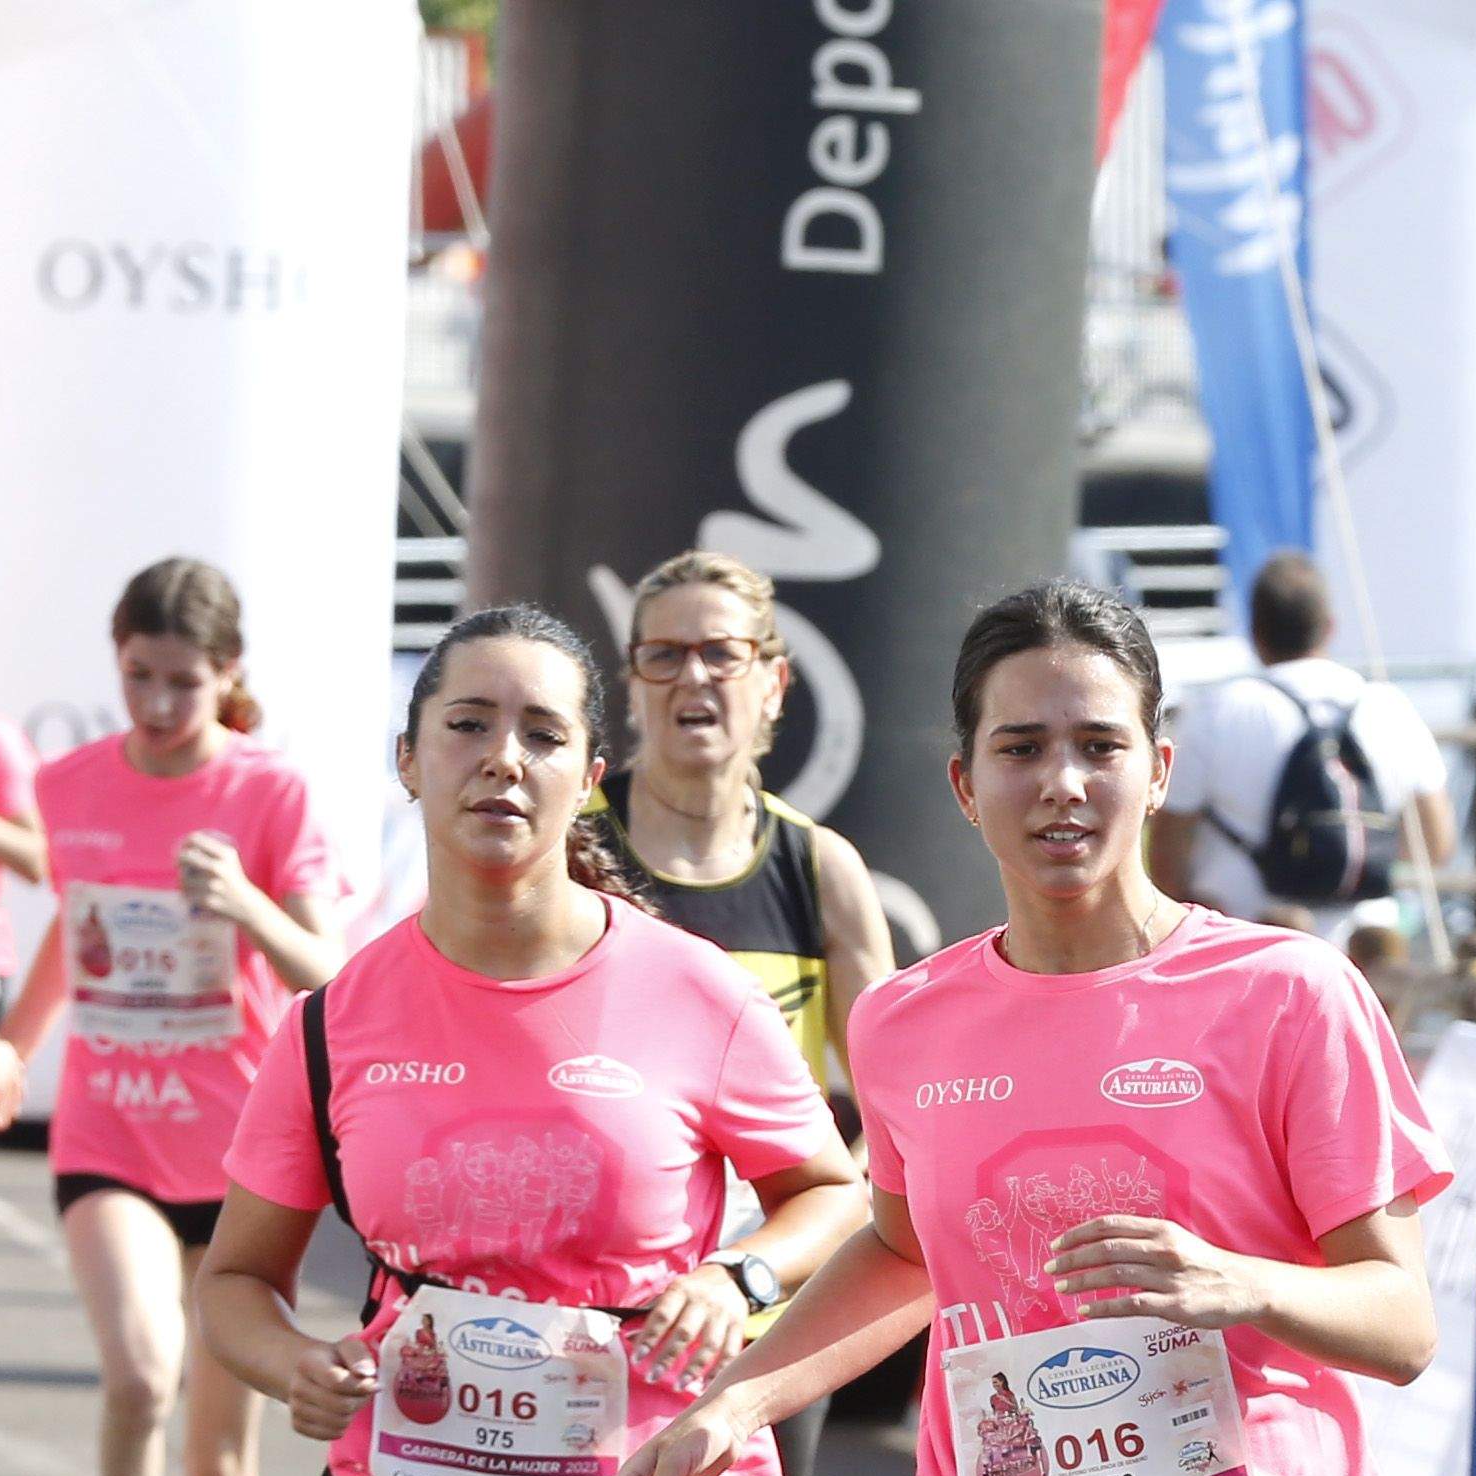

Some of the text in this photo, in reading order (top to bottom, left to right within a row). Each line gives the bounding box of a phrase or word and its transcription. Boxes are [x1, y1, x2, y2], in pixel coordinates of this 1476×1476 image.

[36, 236, 308, 315] OYSH
[365, 1061, 466, 1085] OYSHO
[1108, 1075, 1197, 1095] ASTURIANA
[915, 1075, 1015, 1109] OYSHO
[1146, 1330, 1201, 1357] SUMA
[1038, 1366, 1133, 1400] ASTURIANA
[458, 1382, 538, 1421] 016
[475, 1427, 514, 1449] 975
[1054, 1422, 1145, 1471] 016
[400, 1443, 599, 1474] CARRERA DE LA MUJER 2023
